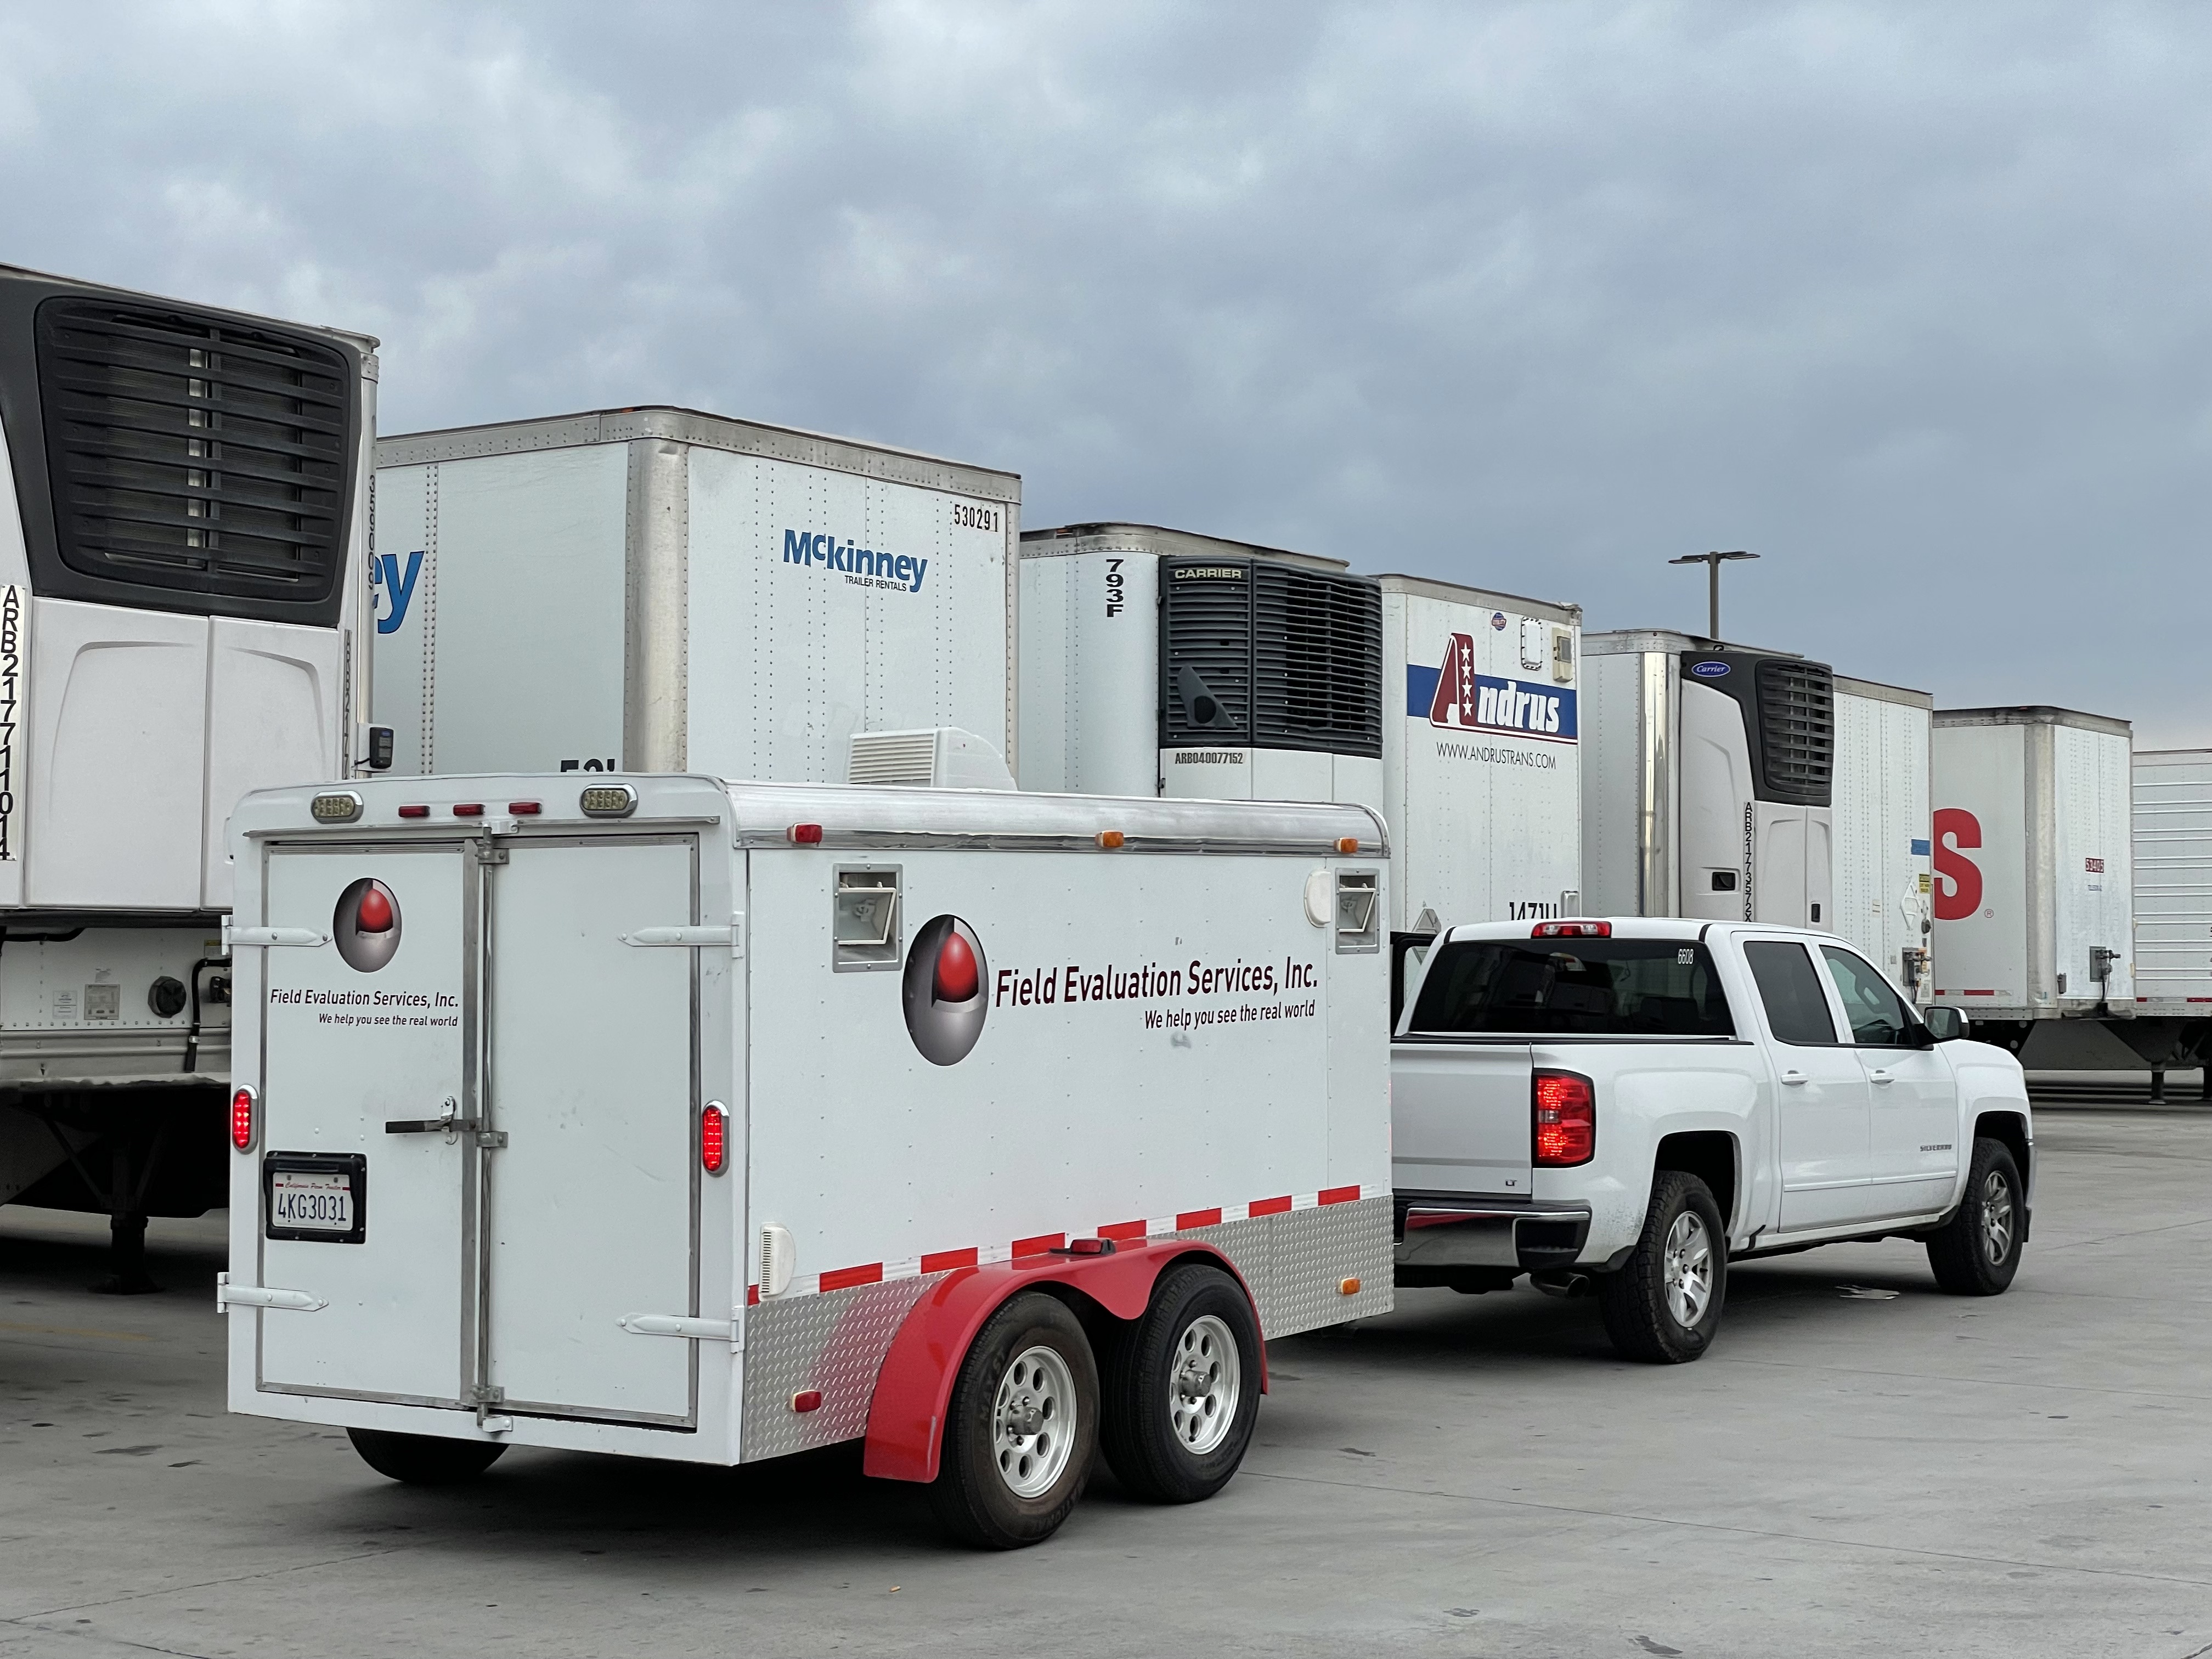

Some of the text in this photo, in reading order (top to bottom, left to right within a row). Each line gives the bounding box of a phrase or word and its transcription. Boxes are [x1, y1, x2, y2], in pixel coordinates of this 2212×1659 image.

[955, 504, 998, 532] 530291
[845, 575, 907, 591] TRAILER RENTALS
[1175, 568, 1242, 579] CARRIER
[1105, 558, 1124, 618] 793F
[1429, 632, 1560, 733] Andrus
[1175, 752, 1243, 764] ARB040077152
[1436, 741, 1556, 769] WWW.ANDRUSTRANS.COM
[1745, 802, 1753, 922] ARB21773572X
[996, 956, 1317, 1007] Field Evaluation Services, Inc.
[270, 989, 459, 1009] Field Evaluation Services, Inc.
[319, 1013, 458, 1027] We help you see the real world
[1145, 999, 1316, 1031] We help you see the real world
[278, 1193, 347, 1222] 4KG3031
